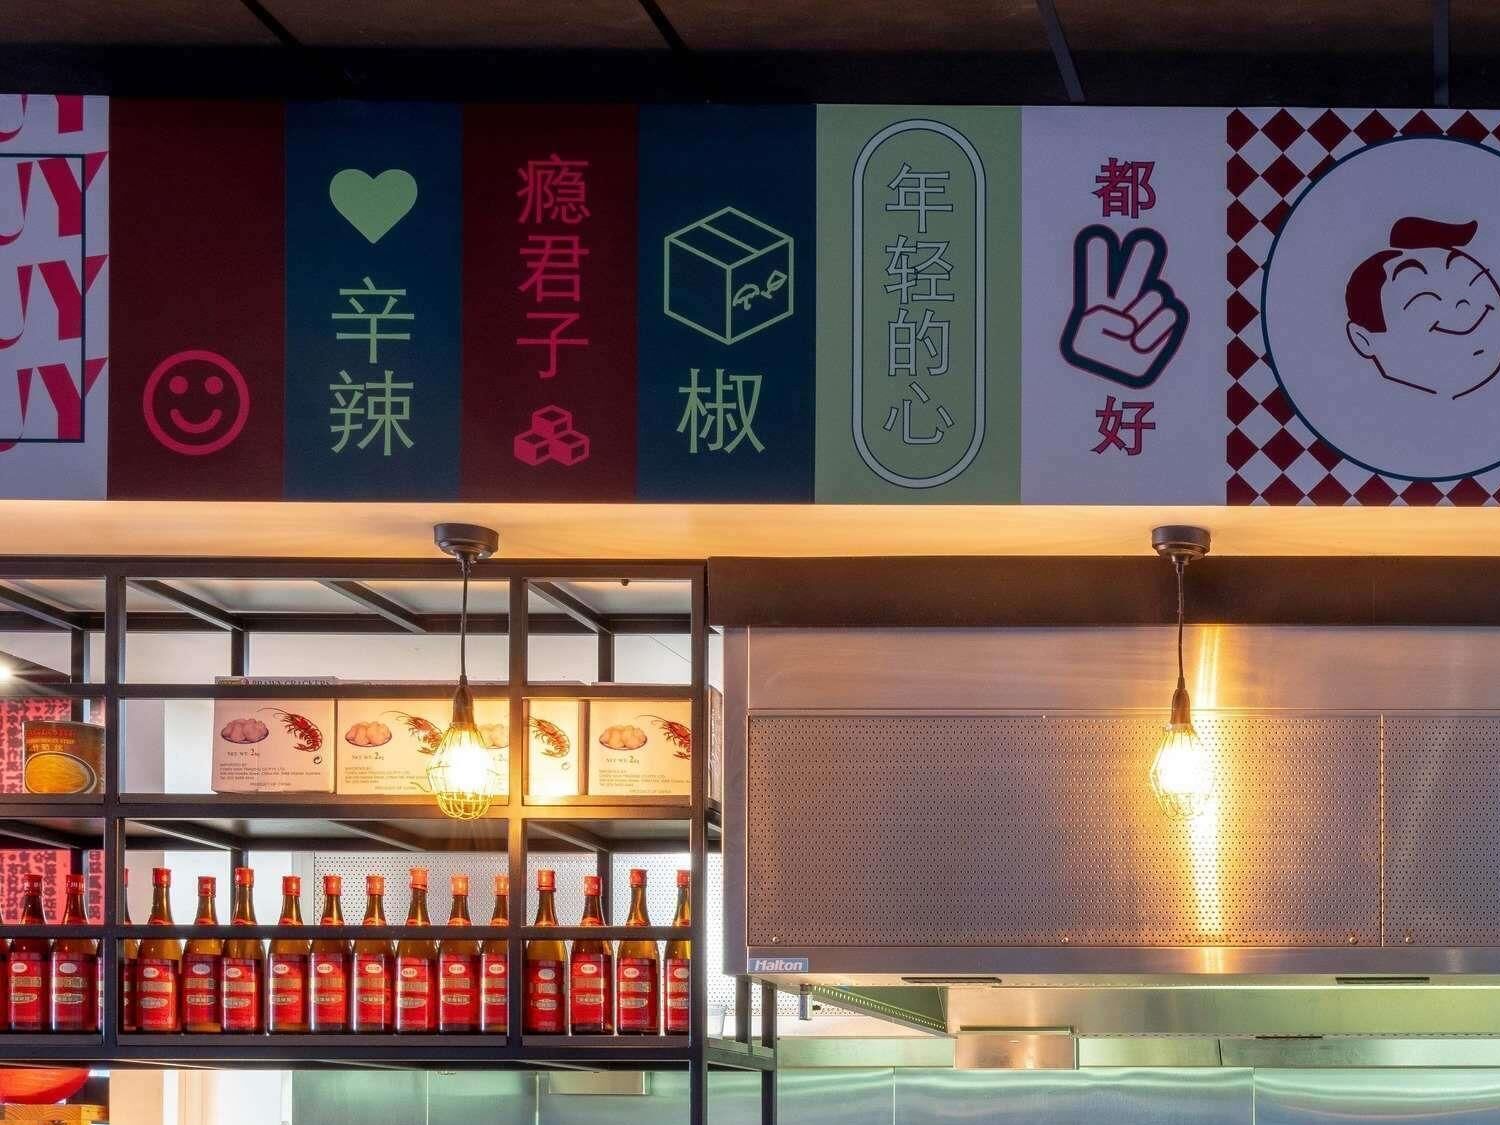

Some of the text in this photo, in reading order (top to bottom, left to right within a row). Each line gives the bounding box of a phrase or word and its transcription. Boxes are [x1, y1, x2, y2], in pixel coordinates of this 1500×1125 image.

[1091, 156, 1157, 218] 都
[515, 153, 591, 380] 瘾君子
[882, 162, 956, 446] 年轻的心
[329, 275, 415, 457] 辛辣
[676, 367, 766, 455] 椒
[1090, 395, 1156, 456] 好
[755, 959, 803, 971] Halton
